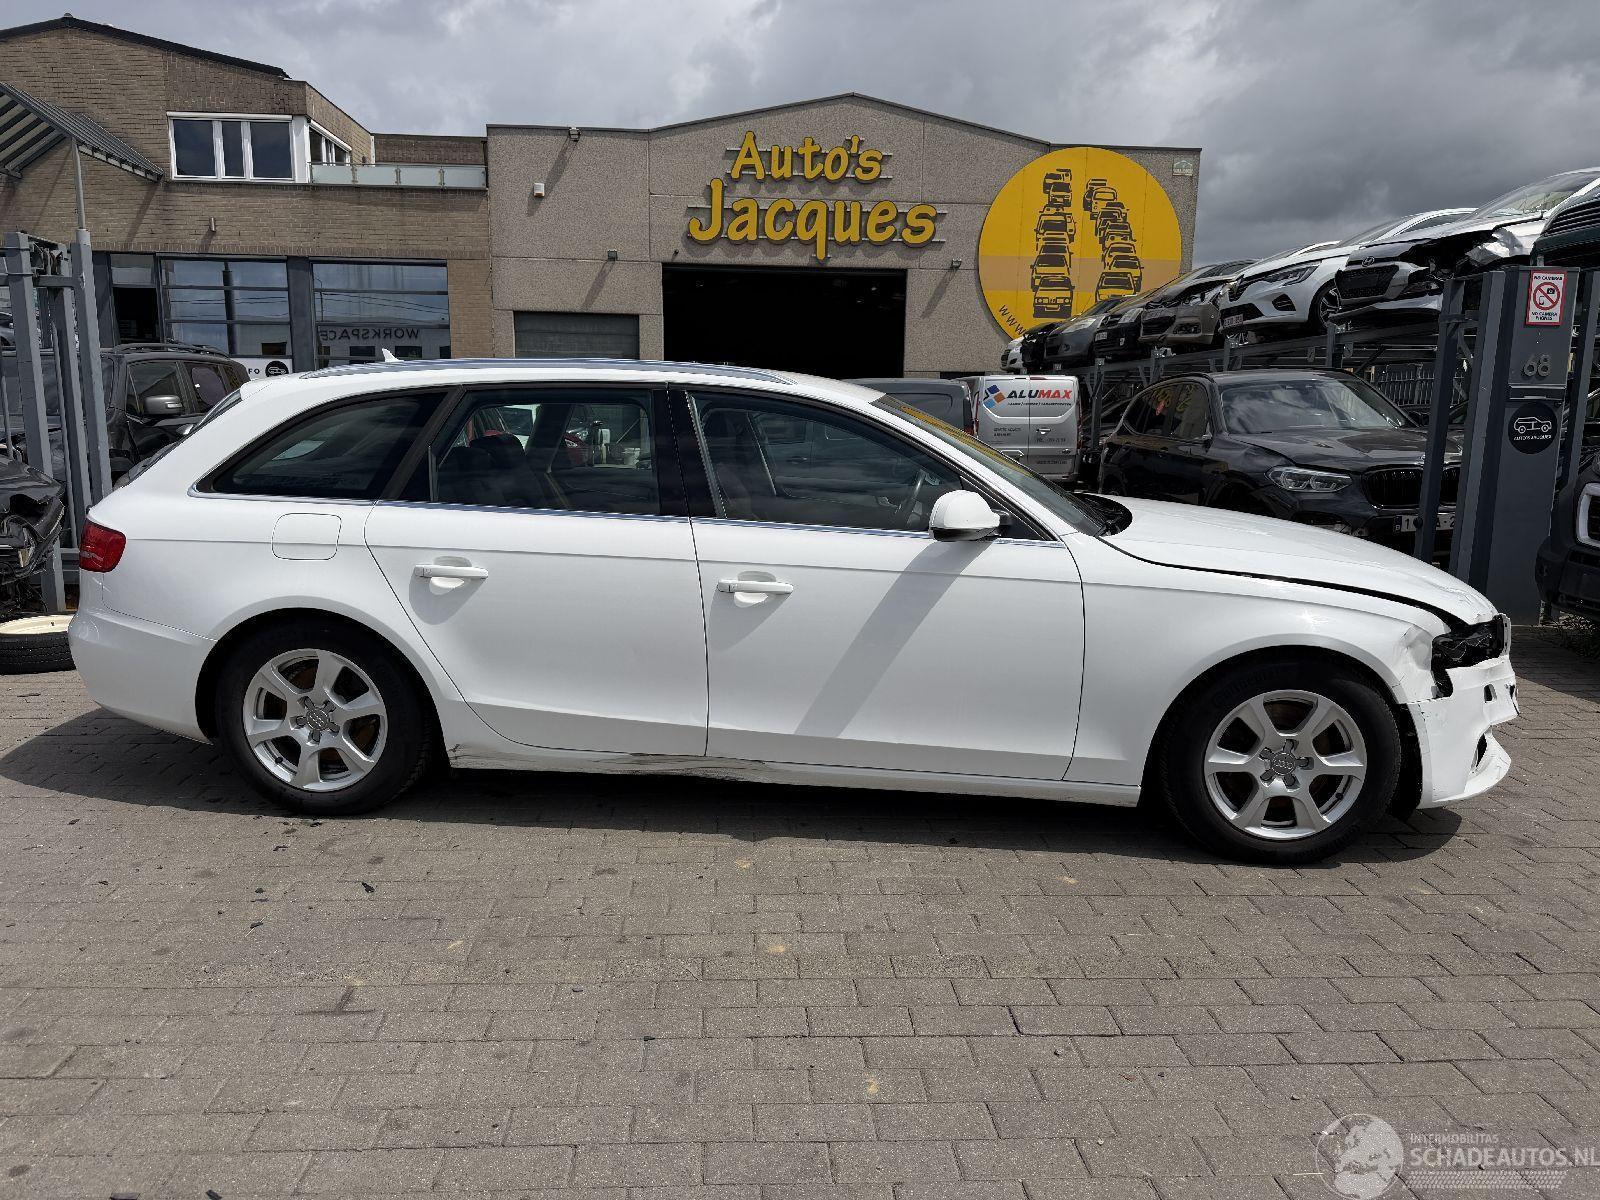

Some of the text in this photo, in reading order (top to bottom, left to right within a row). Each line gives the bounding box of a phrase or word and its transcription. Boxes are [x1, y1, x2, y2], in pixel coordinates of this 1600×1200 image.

[730, 130, 884, 182] Auto's
[688, 178, 938, 261] Jacques
[1523, 354, 1551, 377] 68
[1007, 389, 1072, 399] ALUMAX
